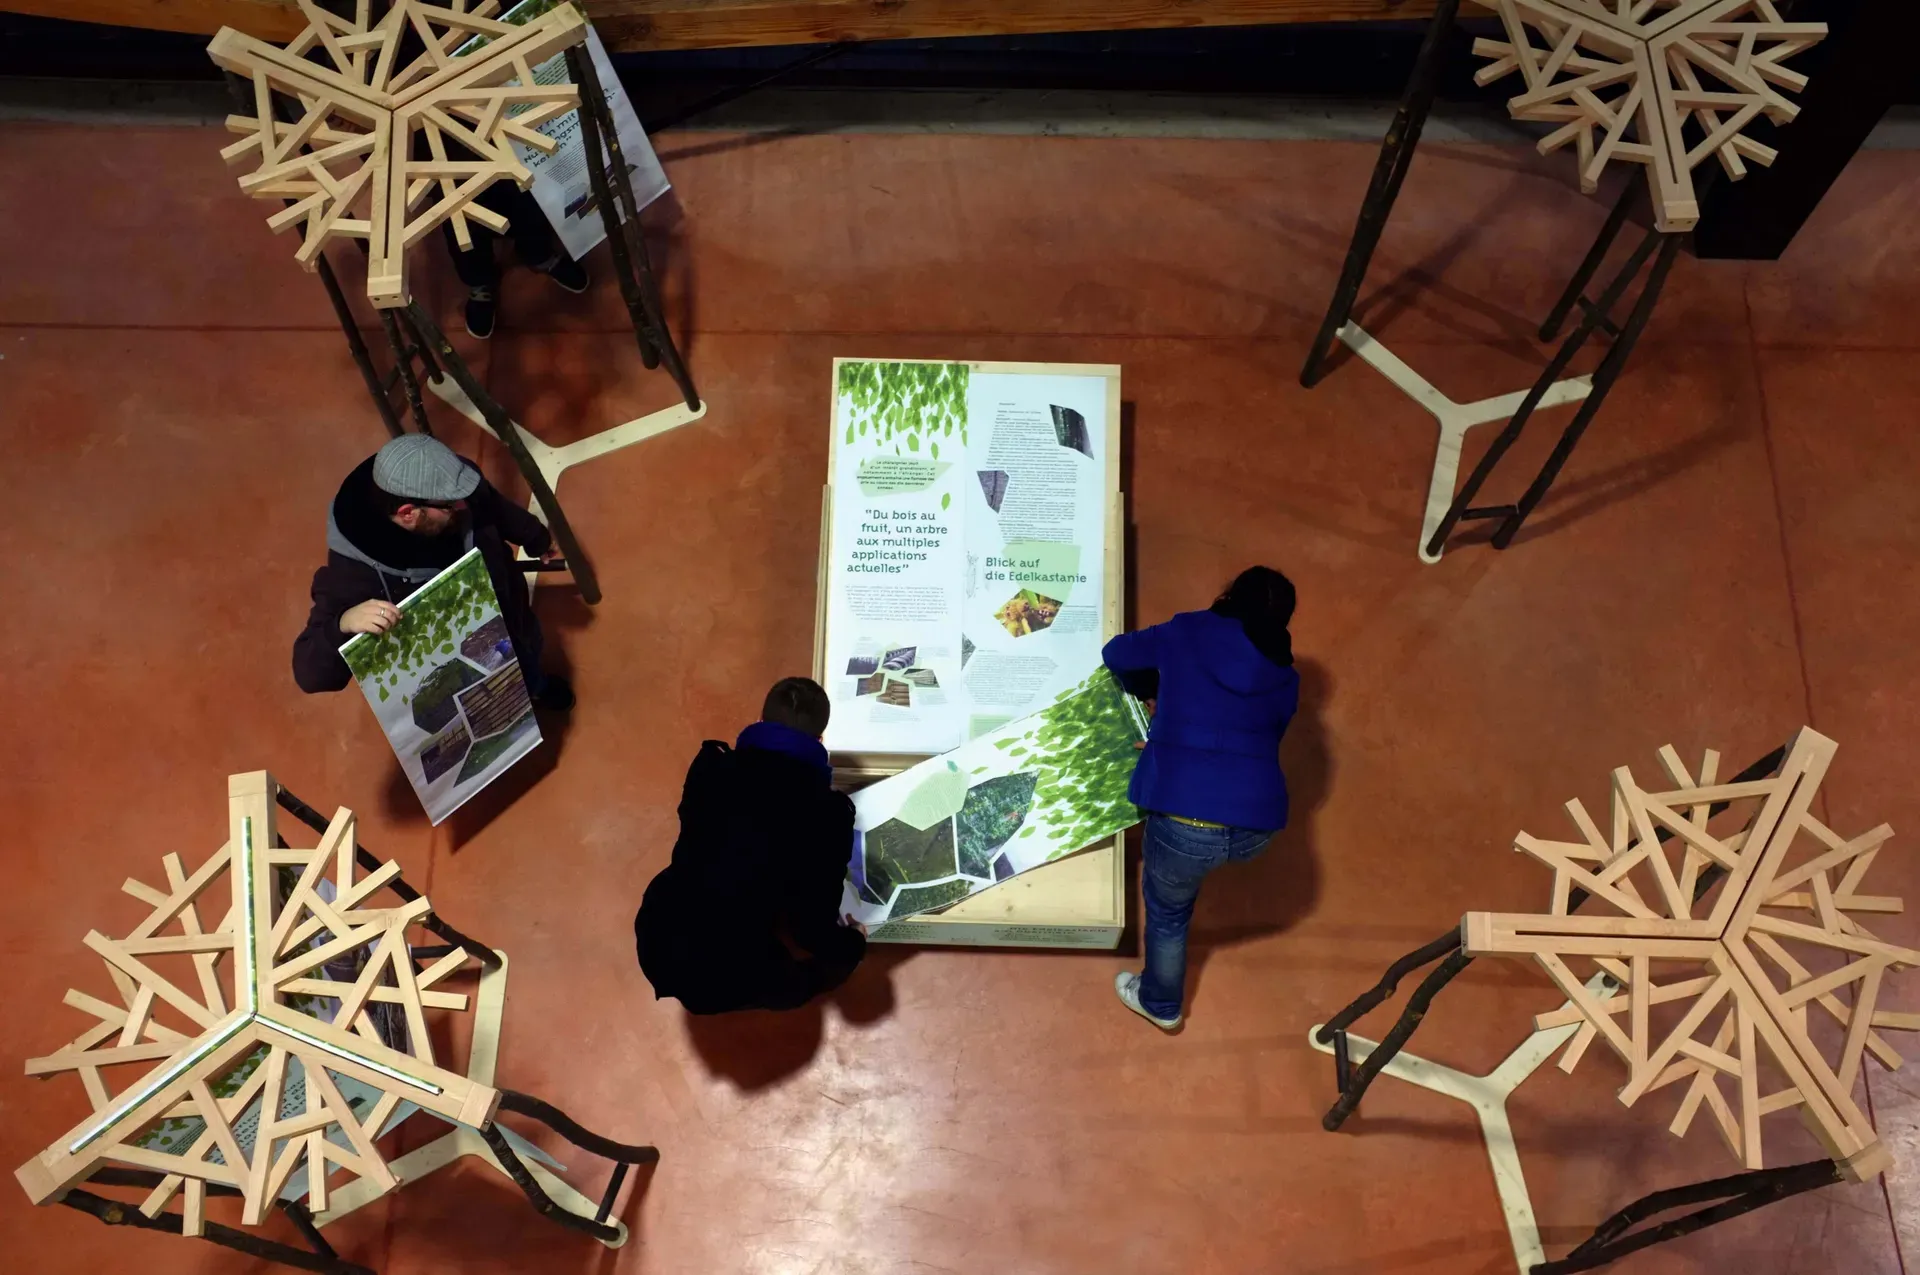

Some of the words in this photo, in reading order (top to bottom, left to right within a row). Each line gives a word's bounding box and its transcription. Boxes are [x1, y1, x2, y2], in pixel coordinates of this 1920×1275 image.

[556, 112, 576, 129] mit
[892, 510, 917, 520] bois
[861, 523, 891, 534] fruit,
[896, 525, 912, 534] un
[916, 525, 948, 534] arbre
[857, 538, 879, 546] aux
[882, 538, 940, 548] multiples
[852, 550, 927, 561] applications
[986, 557, 1016, 567] Blick
[1019, 559, 1040, 568] auf
[985, 570, 1005, 580] die
[1009, 571, 1087, 583] Edelkastanie
